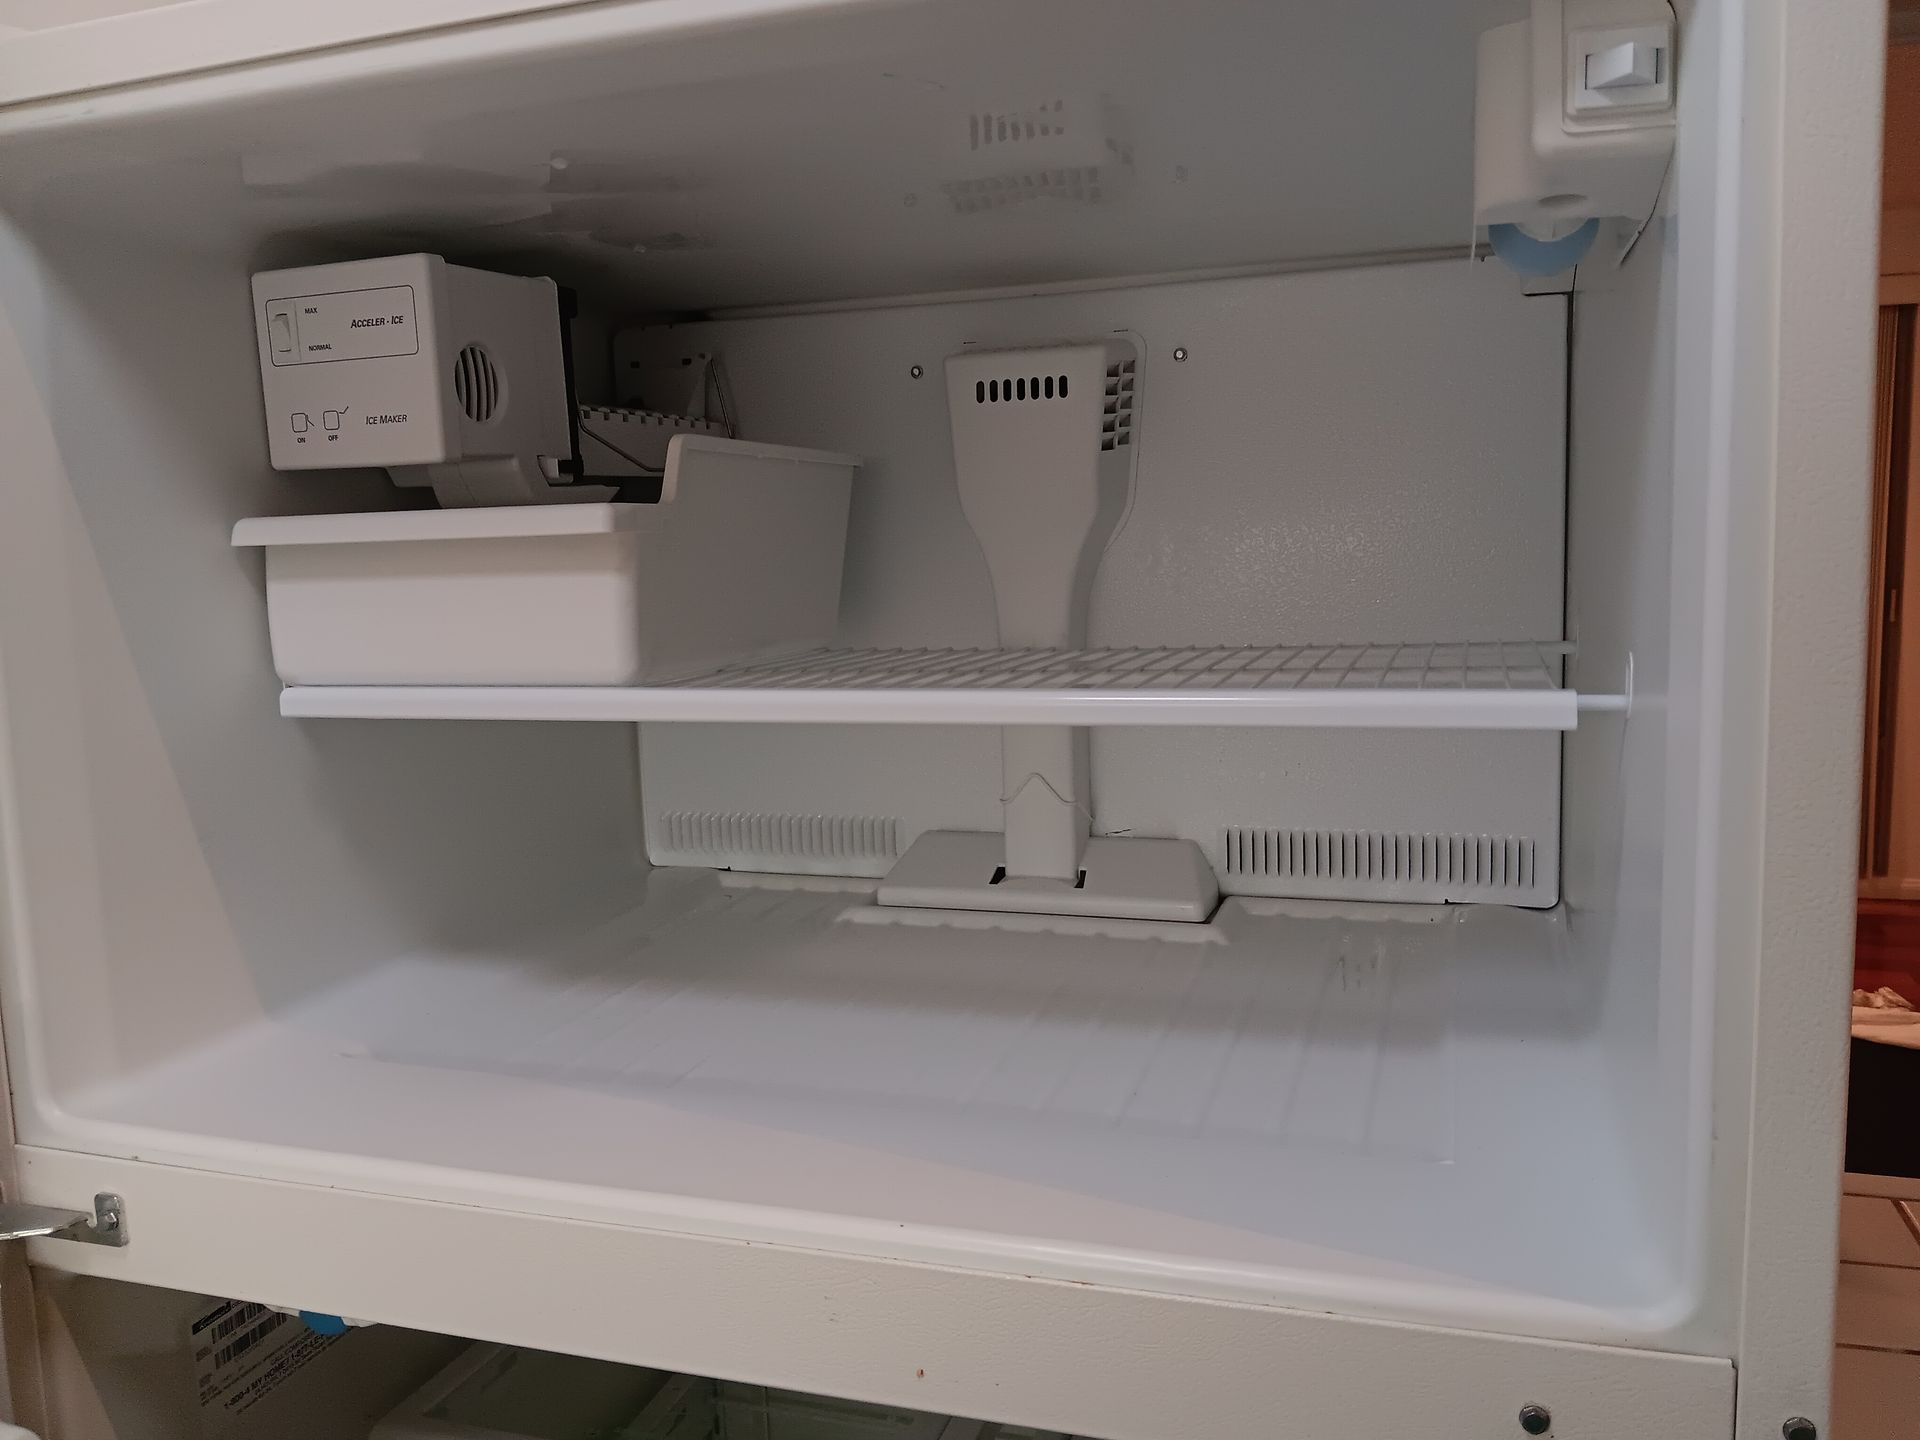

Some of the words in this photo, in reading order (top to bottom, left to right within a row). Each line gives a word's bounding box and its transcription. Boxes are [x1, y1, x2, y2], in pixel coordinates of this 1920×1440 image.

[304, 307, 318, 315] MAX
[350, 316, 386, 329] ACCELER
[391, 315, 404, 325] ICE
[308, 343, 332, 352] NORMAL
[365, 415, 378, 425] ICE
[379, 414, 408, 425] MAKER
